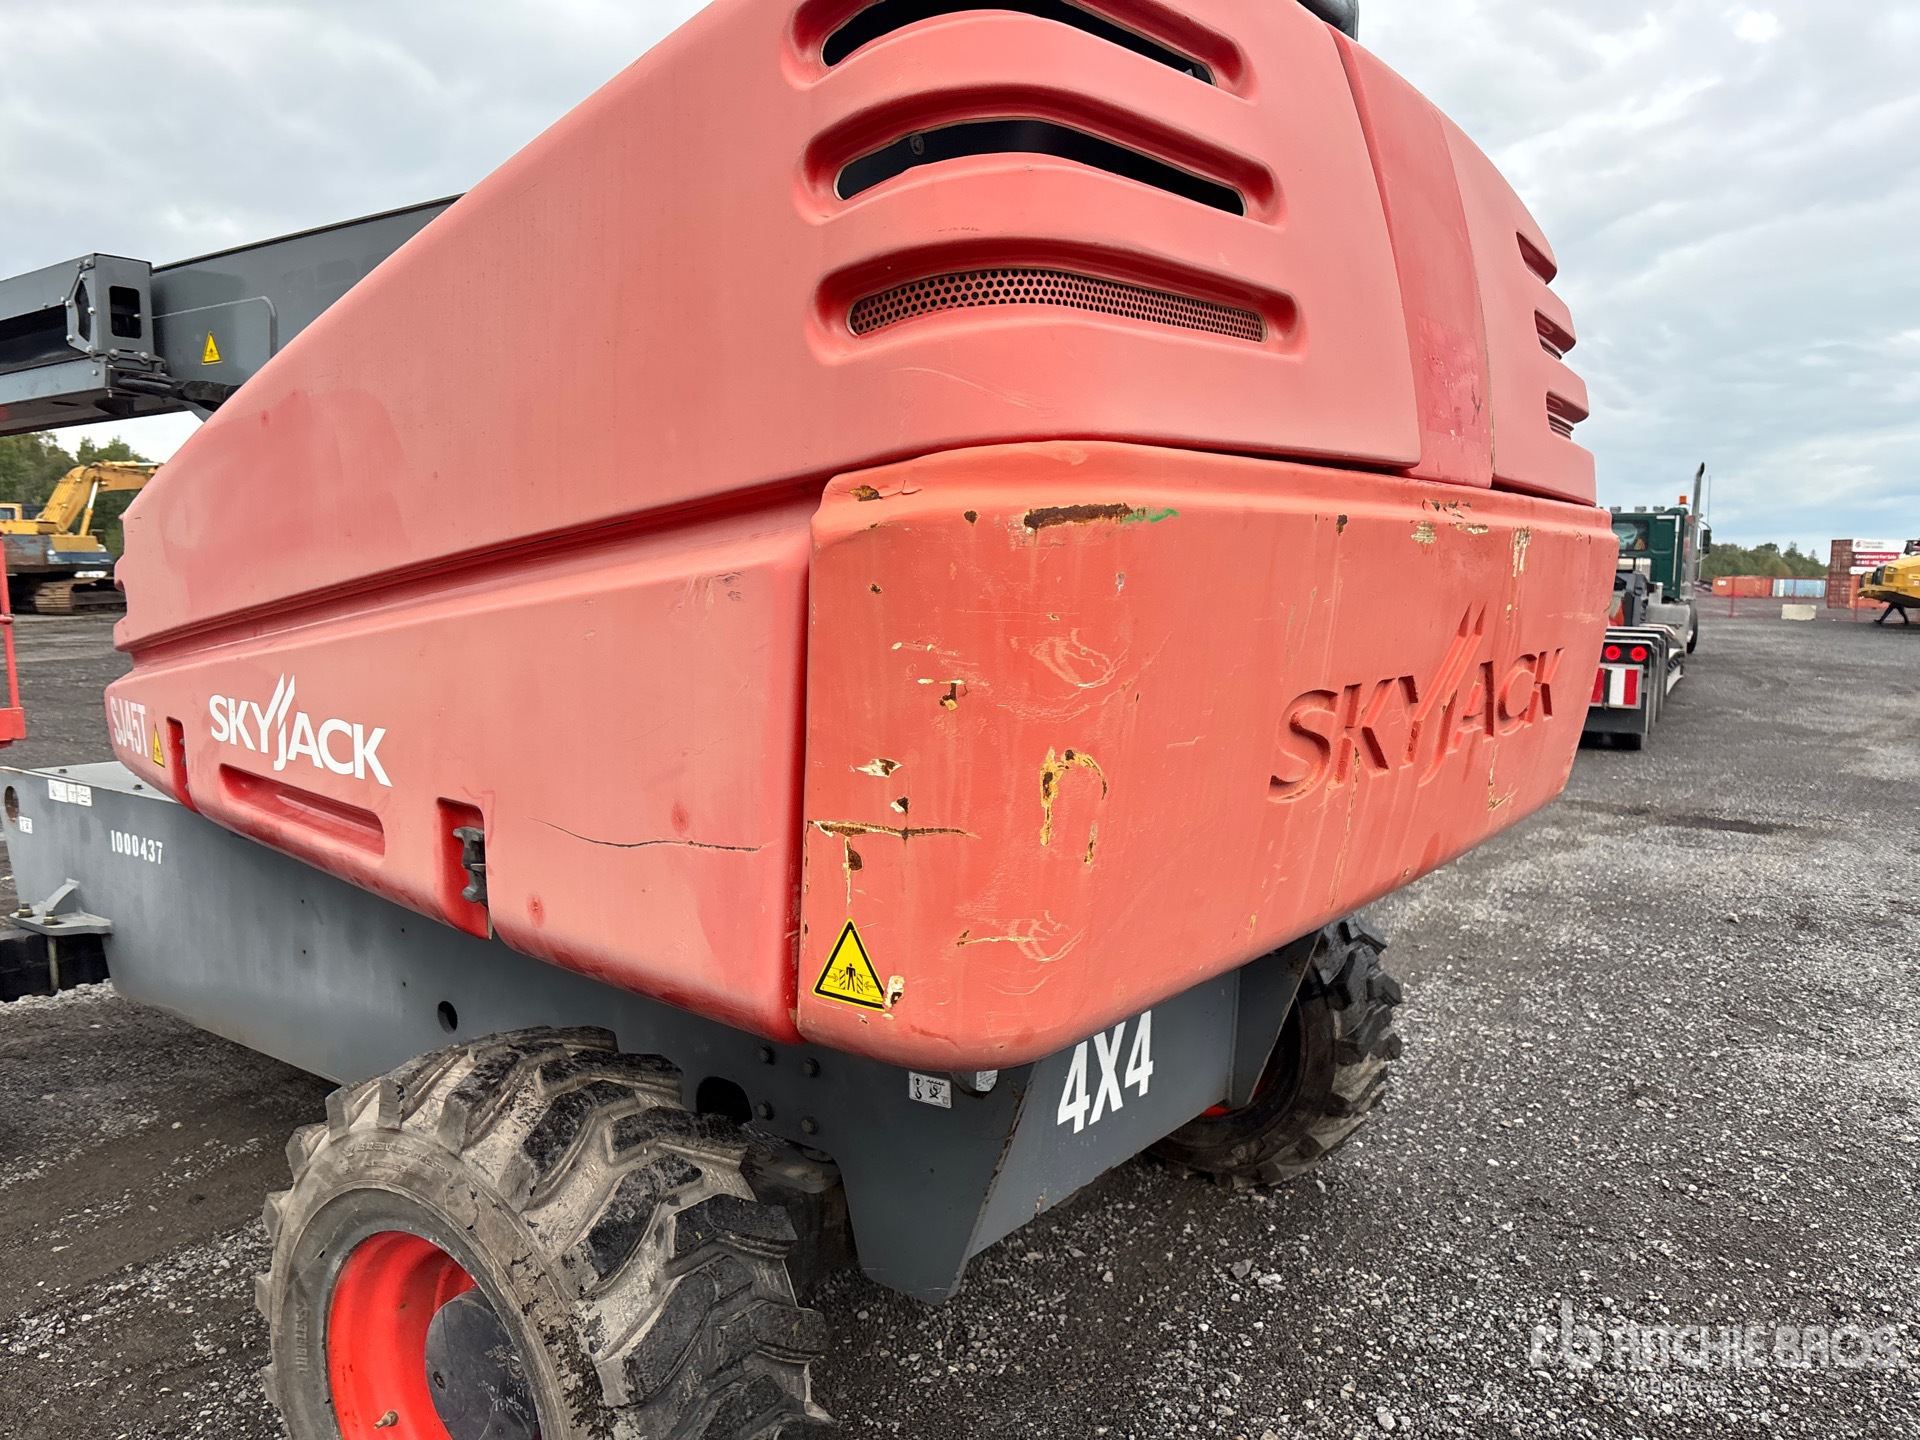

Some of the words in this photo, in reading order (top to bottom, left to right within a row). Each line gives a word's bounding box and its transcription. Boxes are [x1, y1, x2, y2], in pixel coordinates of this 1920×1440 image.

[109, 695, 149, 758] SJ45T
[208, 672, 393, 788] SKYJACK
[1267, 600, 1565, 803] SKYJACK
[110, 829, 163, 865] 1000437
[1056, 1009, 1154, 1135] 4X4
